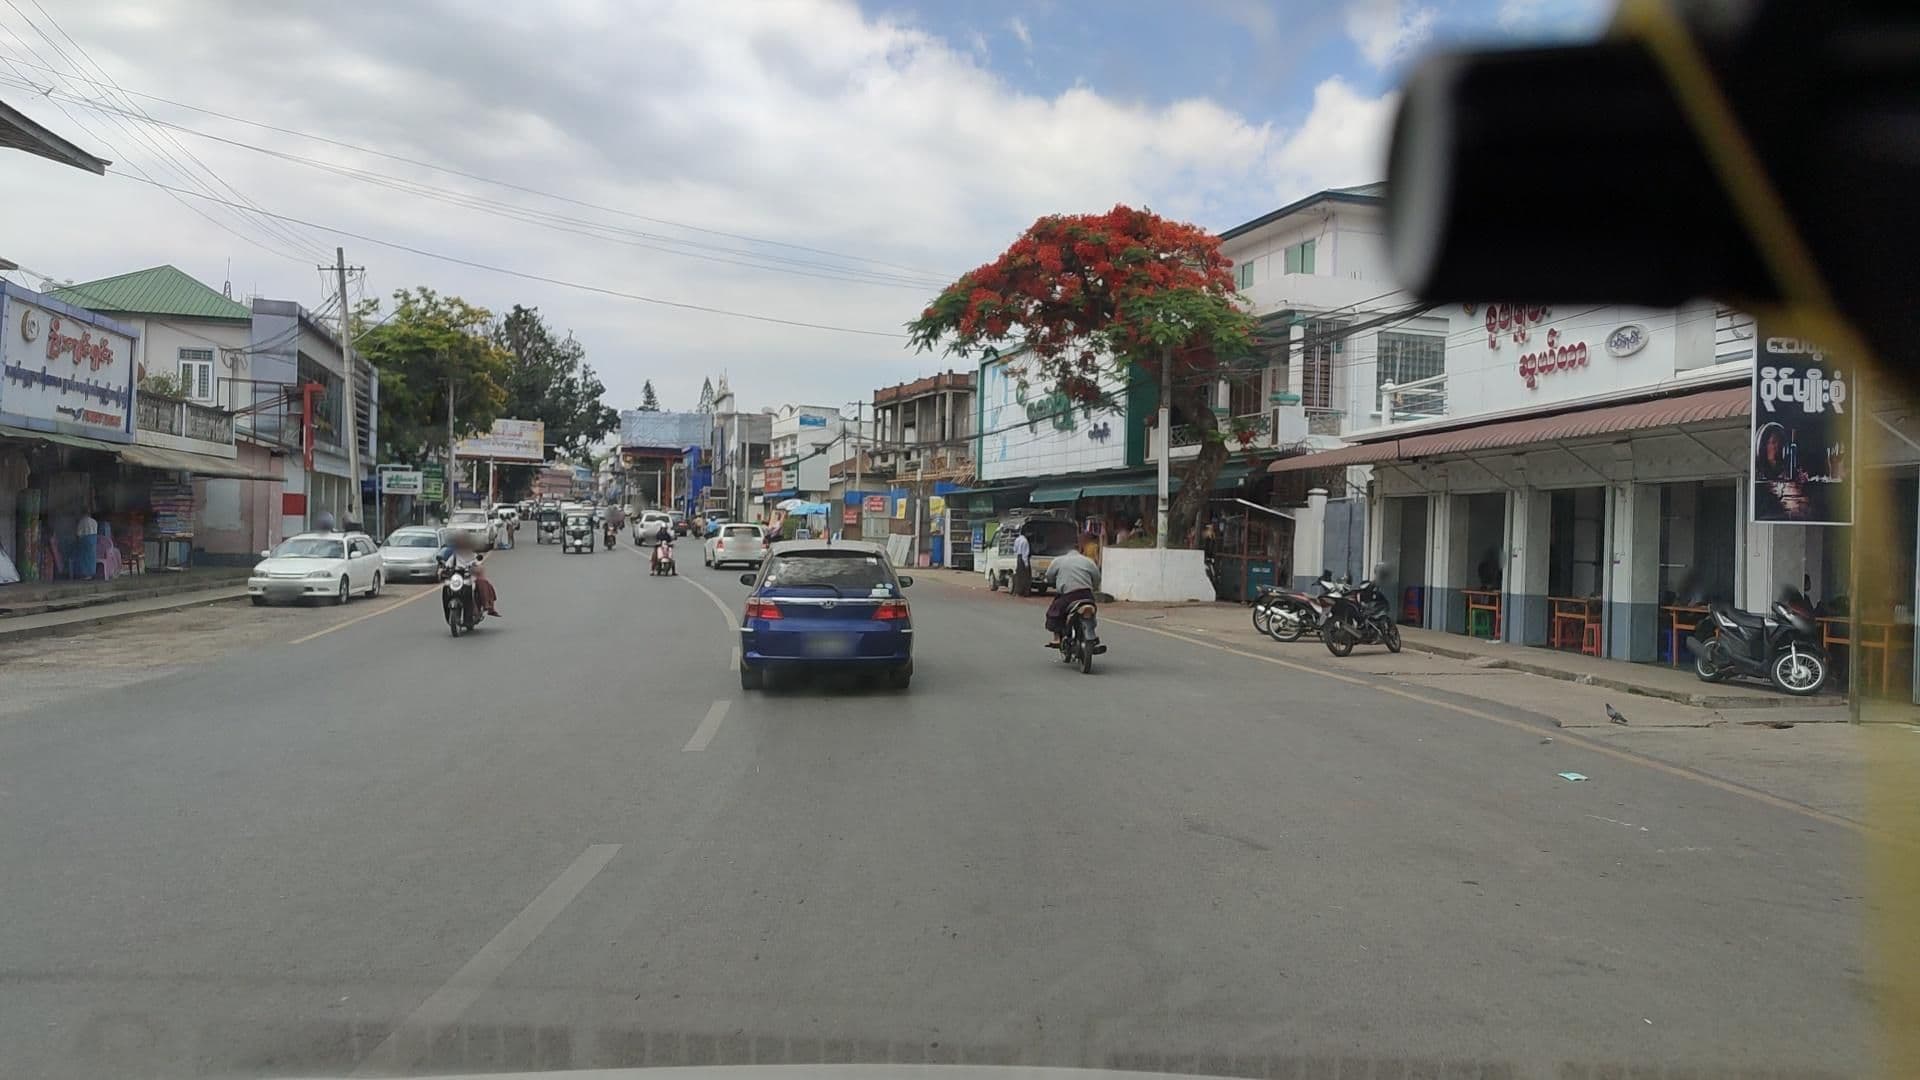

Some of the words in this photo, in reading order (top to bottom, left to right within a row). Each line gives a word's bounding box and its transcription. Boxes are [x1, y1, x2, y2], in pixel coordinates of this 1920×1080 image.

[1760, 366, 1847, 414] ဝိုင်မျိုးစုံ
